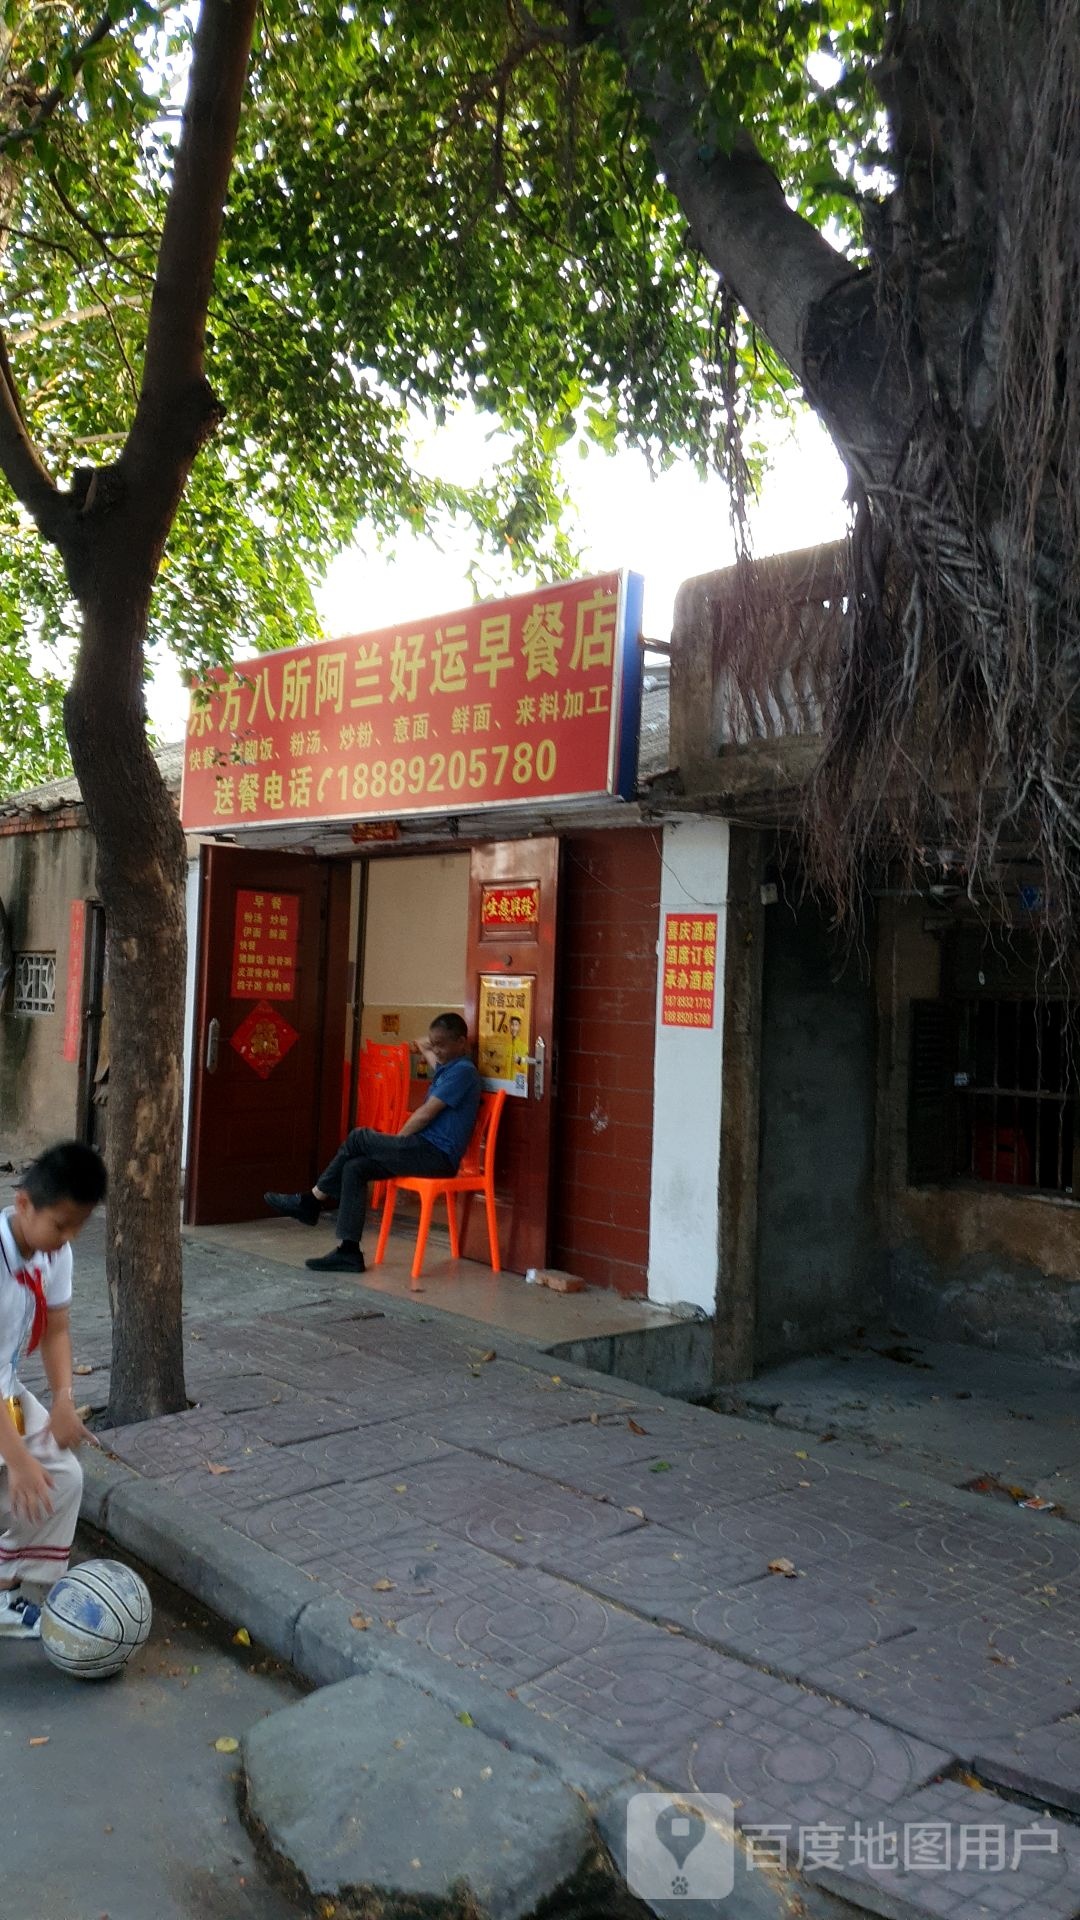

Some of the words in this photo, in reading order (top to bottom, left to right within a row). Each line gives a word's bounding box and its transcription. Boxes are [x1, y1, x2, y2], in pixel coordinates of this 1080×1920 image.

[188, 588, 618, 737] 东方八所阿兰好运早餐店
[213, 765, 313, 816] 送餐电话
[337, 738, 557, 802] 18889205780
[666, 920, 716, 942] 喜庆酒席
[665, 944, 715, 967] 酒席订餐
[664, 968, 714, 992] 承办酒席
